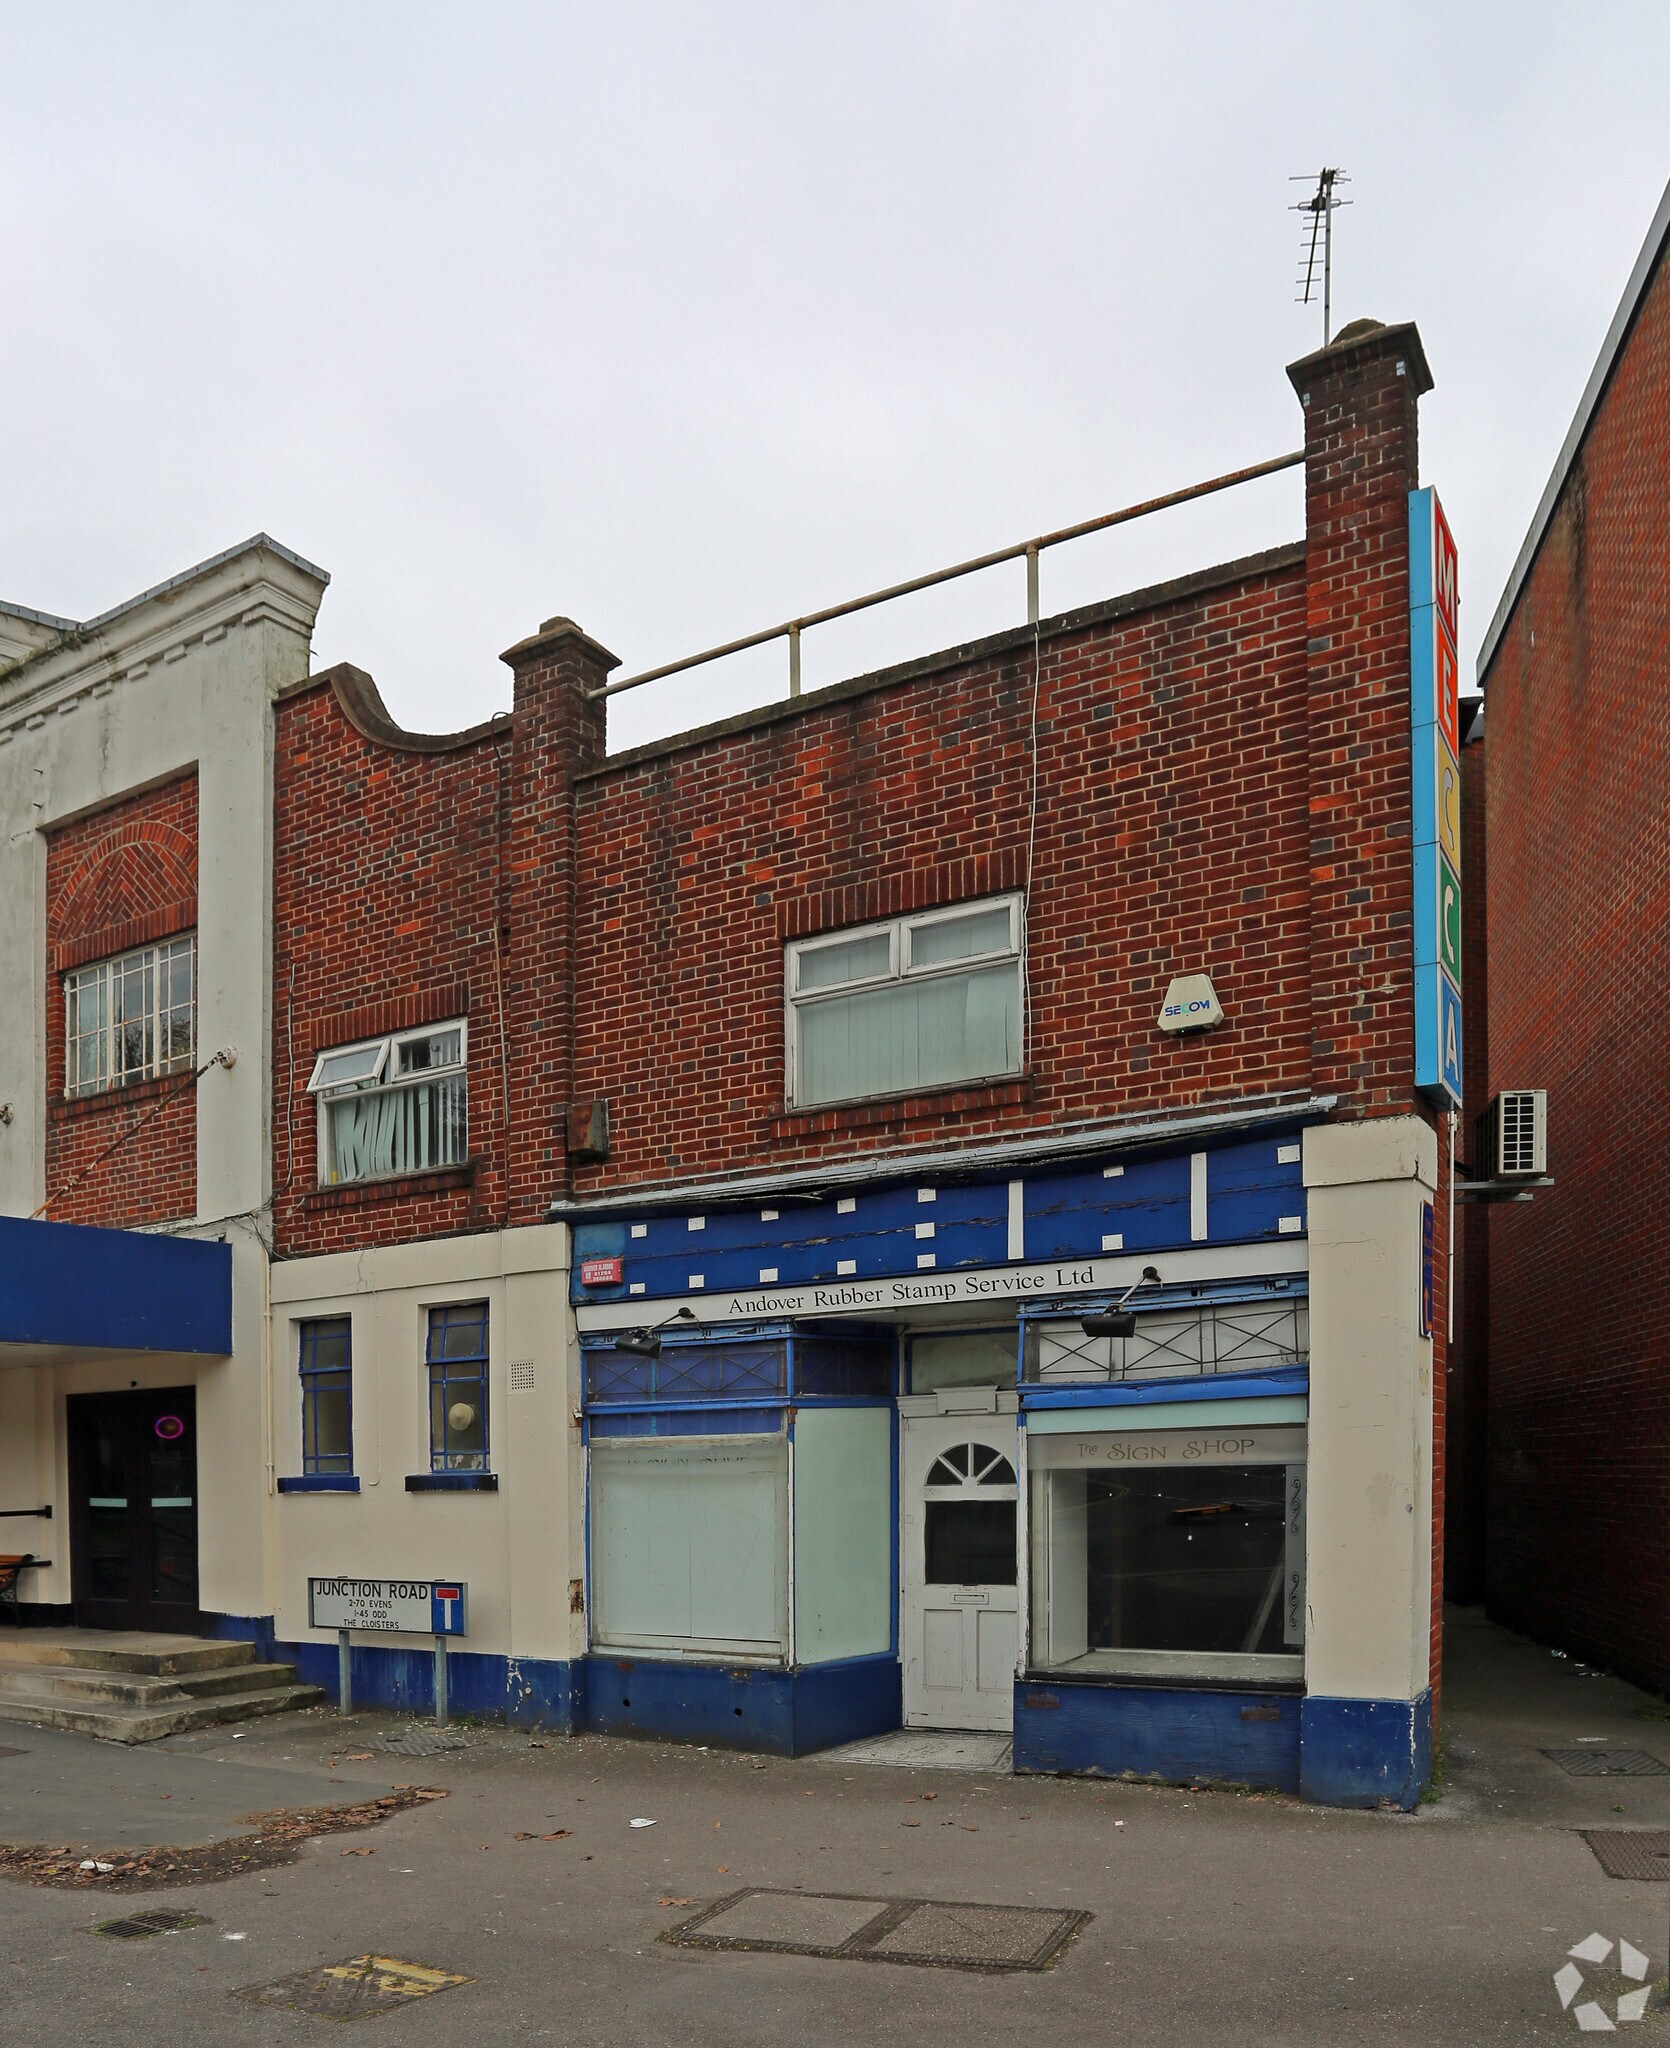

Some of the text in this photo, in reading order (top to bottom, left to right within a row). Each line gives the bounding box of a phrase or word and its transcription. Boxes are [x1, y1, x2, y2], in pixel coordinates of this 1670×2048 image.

[1437, 523, 1460, 1083] MECCA
[1164, 1000, 1210, 1017] SECOM
[729, 1266, 1095, 1314] Andover Rubber Stamp Service Ltd
[1182, 1439, 1255, 1460] SHOP
[316, 1581, 428, 1600] JUNCTION ROAD
[349, 1599, 393, 1609] 2-70 EVENS
[354, 1609, 387, 1619] 1-45 ODD
[343, 1619, 400, 1630] THE CLOISTERS
